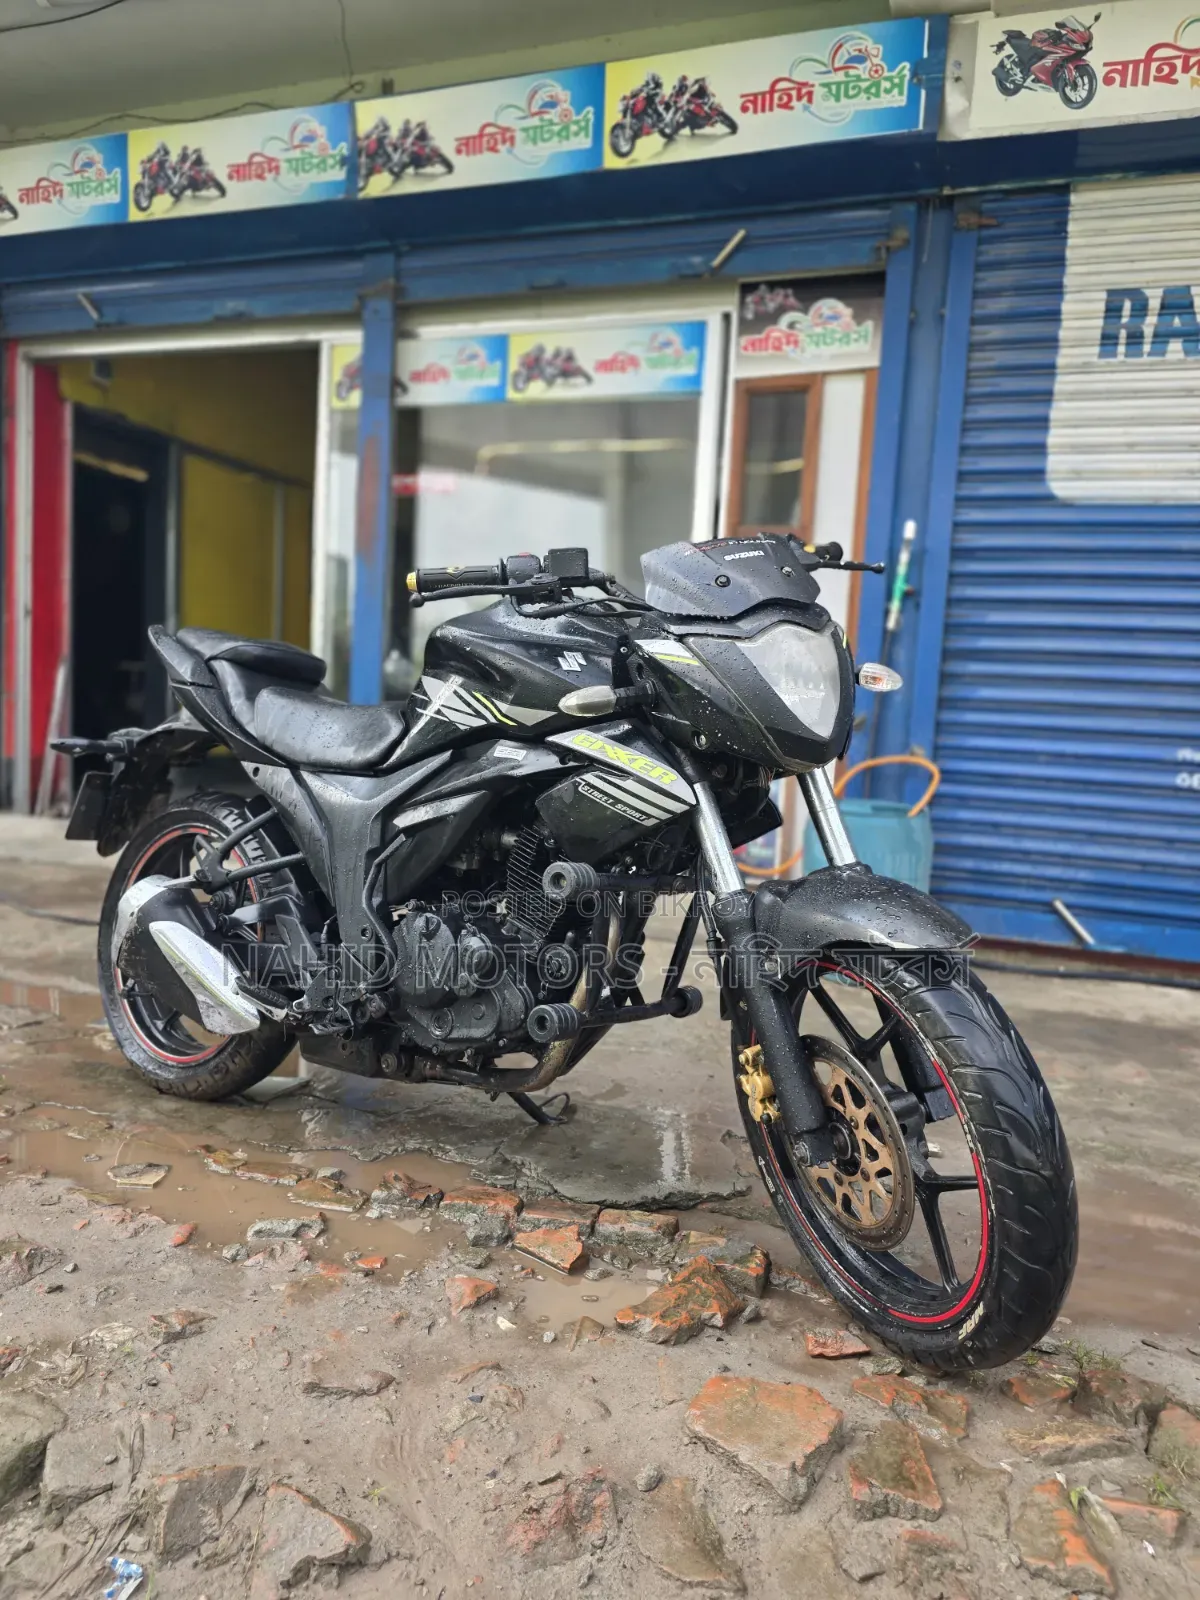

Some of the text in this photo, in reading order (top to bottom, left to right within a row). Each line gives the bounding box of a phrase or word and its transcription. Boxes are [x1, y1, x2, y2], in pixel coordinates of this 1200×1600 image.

[739, 77, 815, 114] নাহিদ
[454, 122, 517, 156] নাহিদ
[226, 152, 281, 182] নাহিদ
[18, 177, 64, 205] নাহিদ
[723, 550, 765, 561] SUZUKI
[570, 733, 679, 786] GIXXER
[581, 783, 649, 822] STREET SPORT
